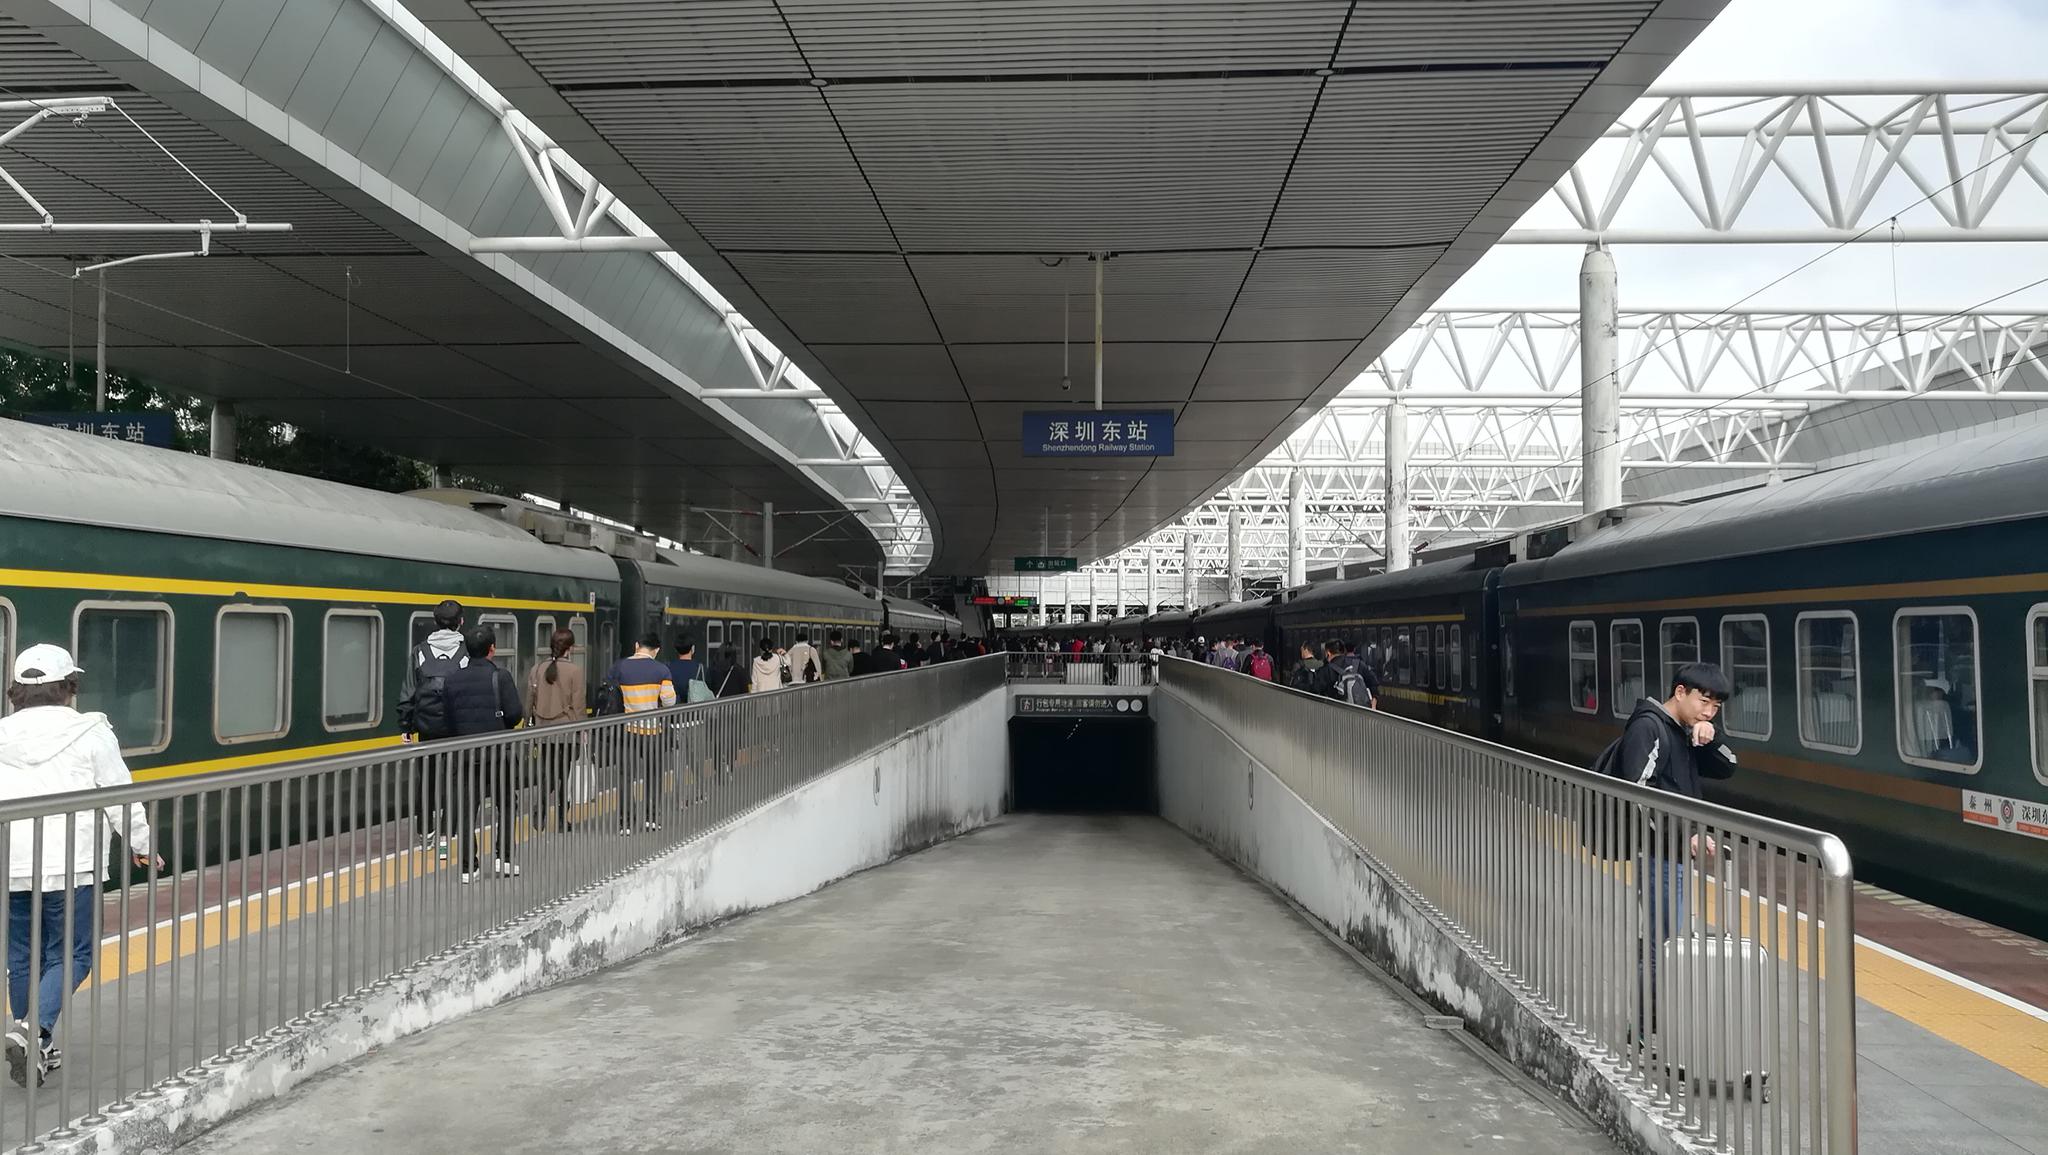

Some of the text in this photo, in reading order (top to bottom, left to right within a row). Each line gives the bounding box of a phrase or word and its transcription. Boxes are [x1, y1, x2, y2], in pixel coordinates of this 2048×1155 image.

[1049, 420, 1148, 442] 深圳东站
[1098, 443, 1127, 453] Railway
[1129, 443, 1155, 451] Station
